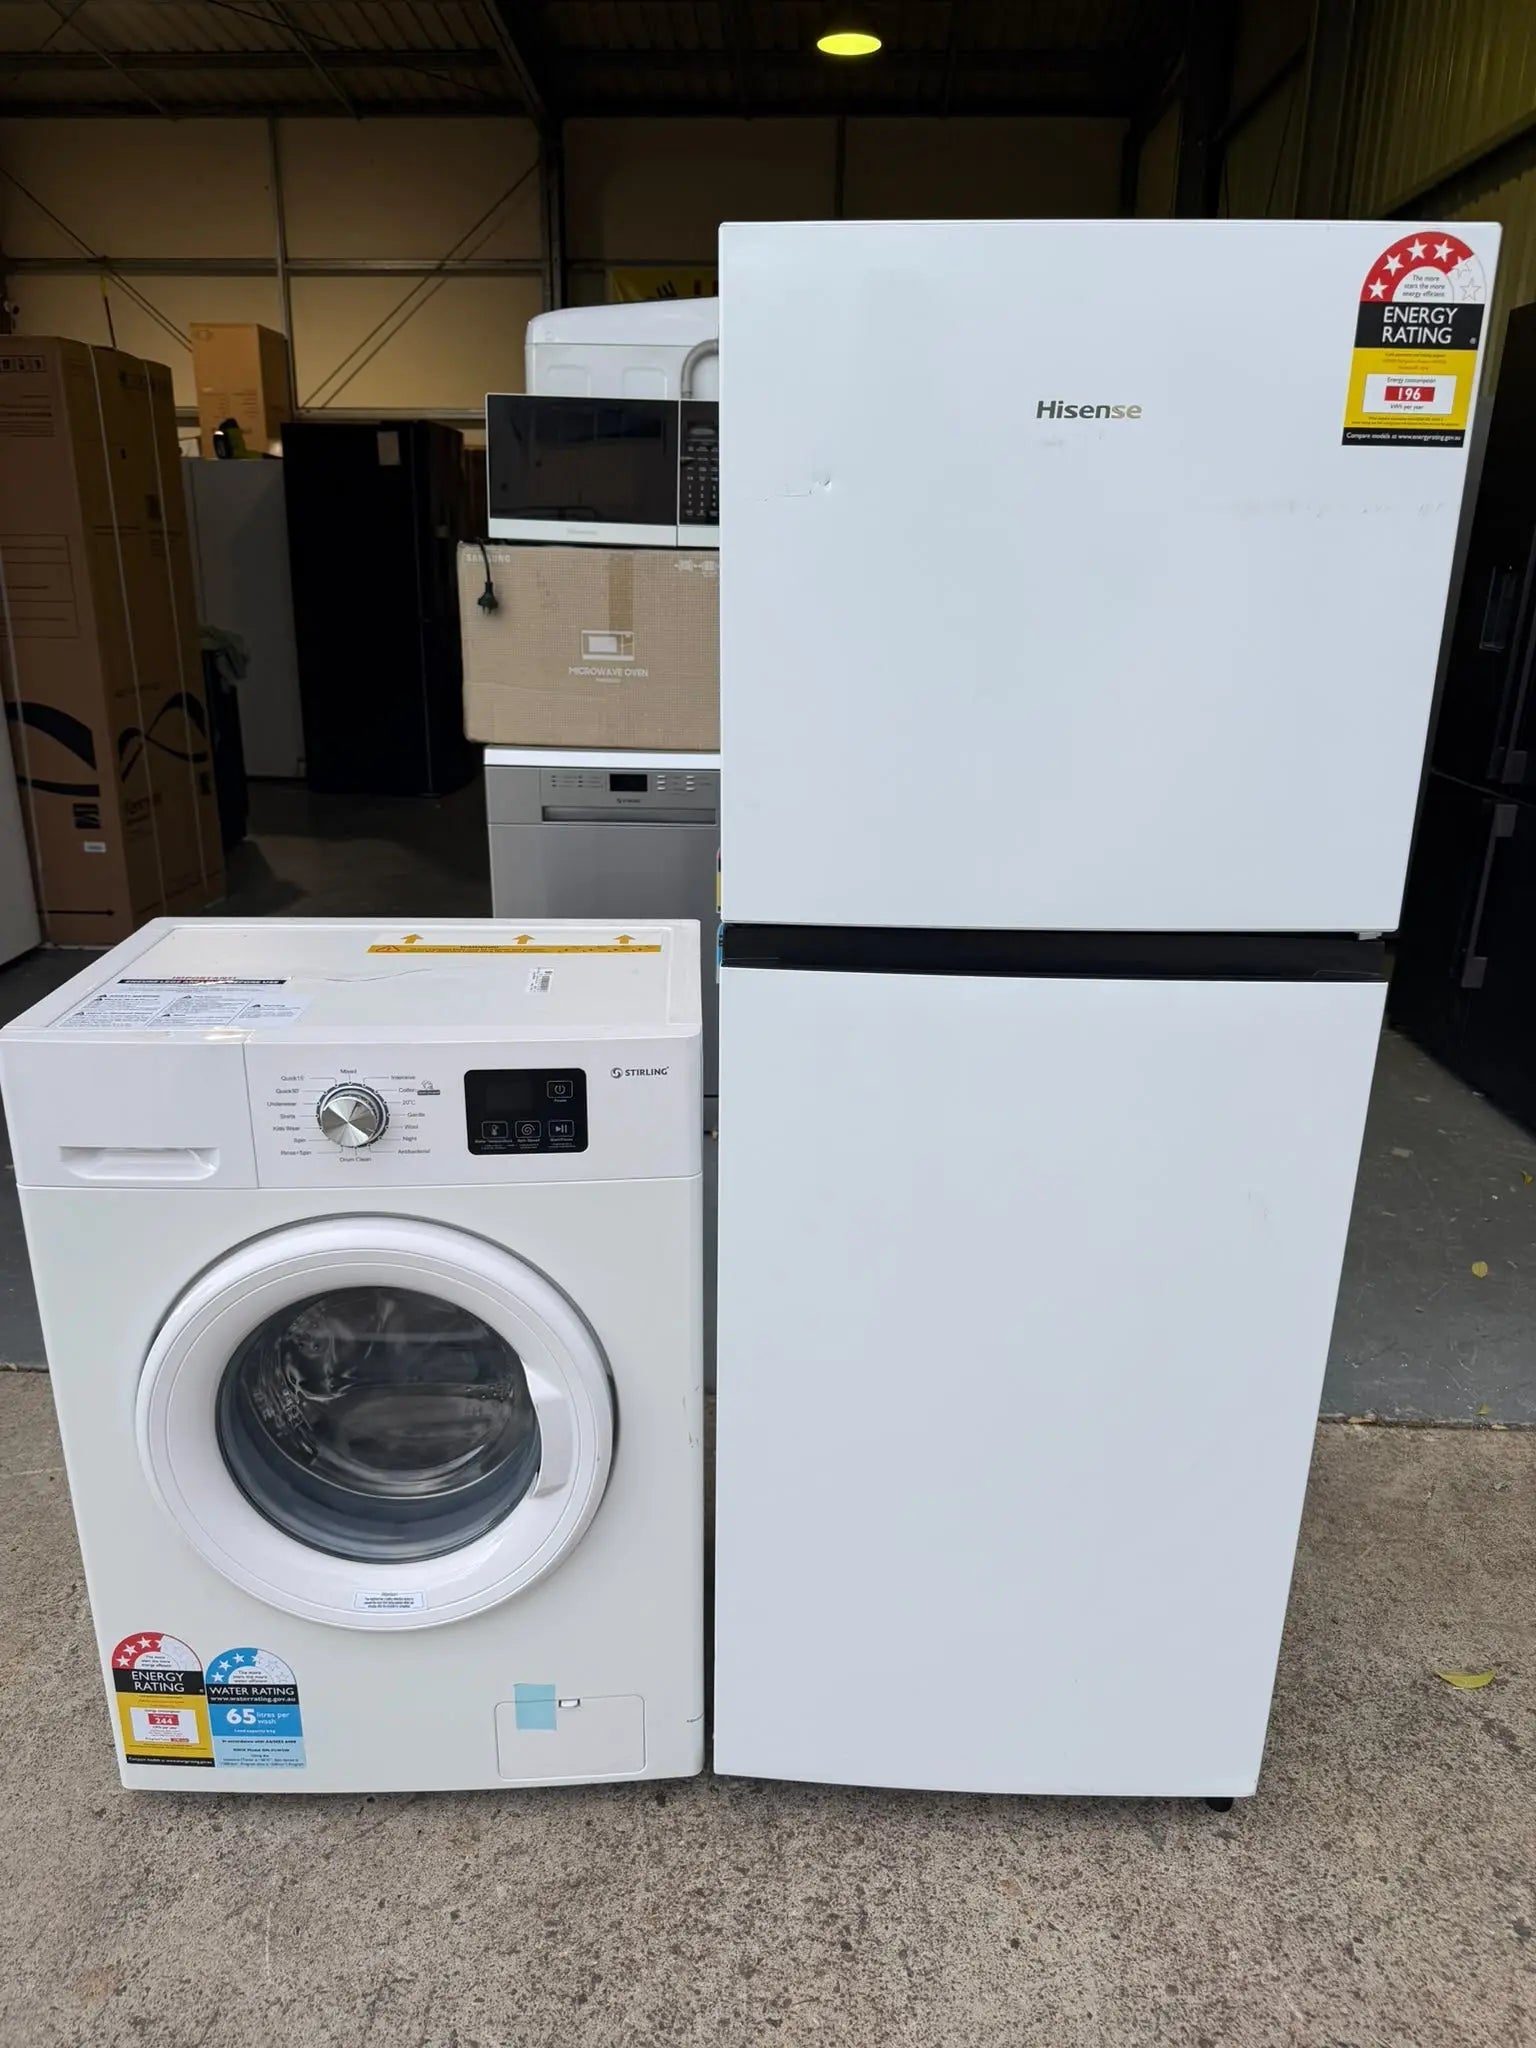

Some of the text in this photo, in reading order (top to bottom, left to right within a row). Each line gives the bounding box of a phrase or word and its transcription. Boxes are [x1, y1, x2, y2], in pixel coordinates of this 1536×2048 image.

[1383, 306, 1458, 324] ENERGY
[1382, 326, 1453, 344] RATING
[1398, 387, 1421, 401] 196
[1036, 401, 1142, 418] Hisense
[1346, 432, 1371, 440] Compare
[568, 667, 648, 677] MICROWAVE OVEN
[625, 1068, 667, 1076] STIRLING
[131, 1671, 184, 1682] ENERGY
[134, 1682, 184, 1692] RATING
[209, 1687, 294, 1695] WATER RATING
[226, 1708, 256, 1724] 65
